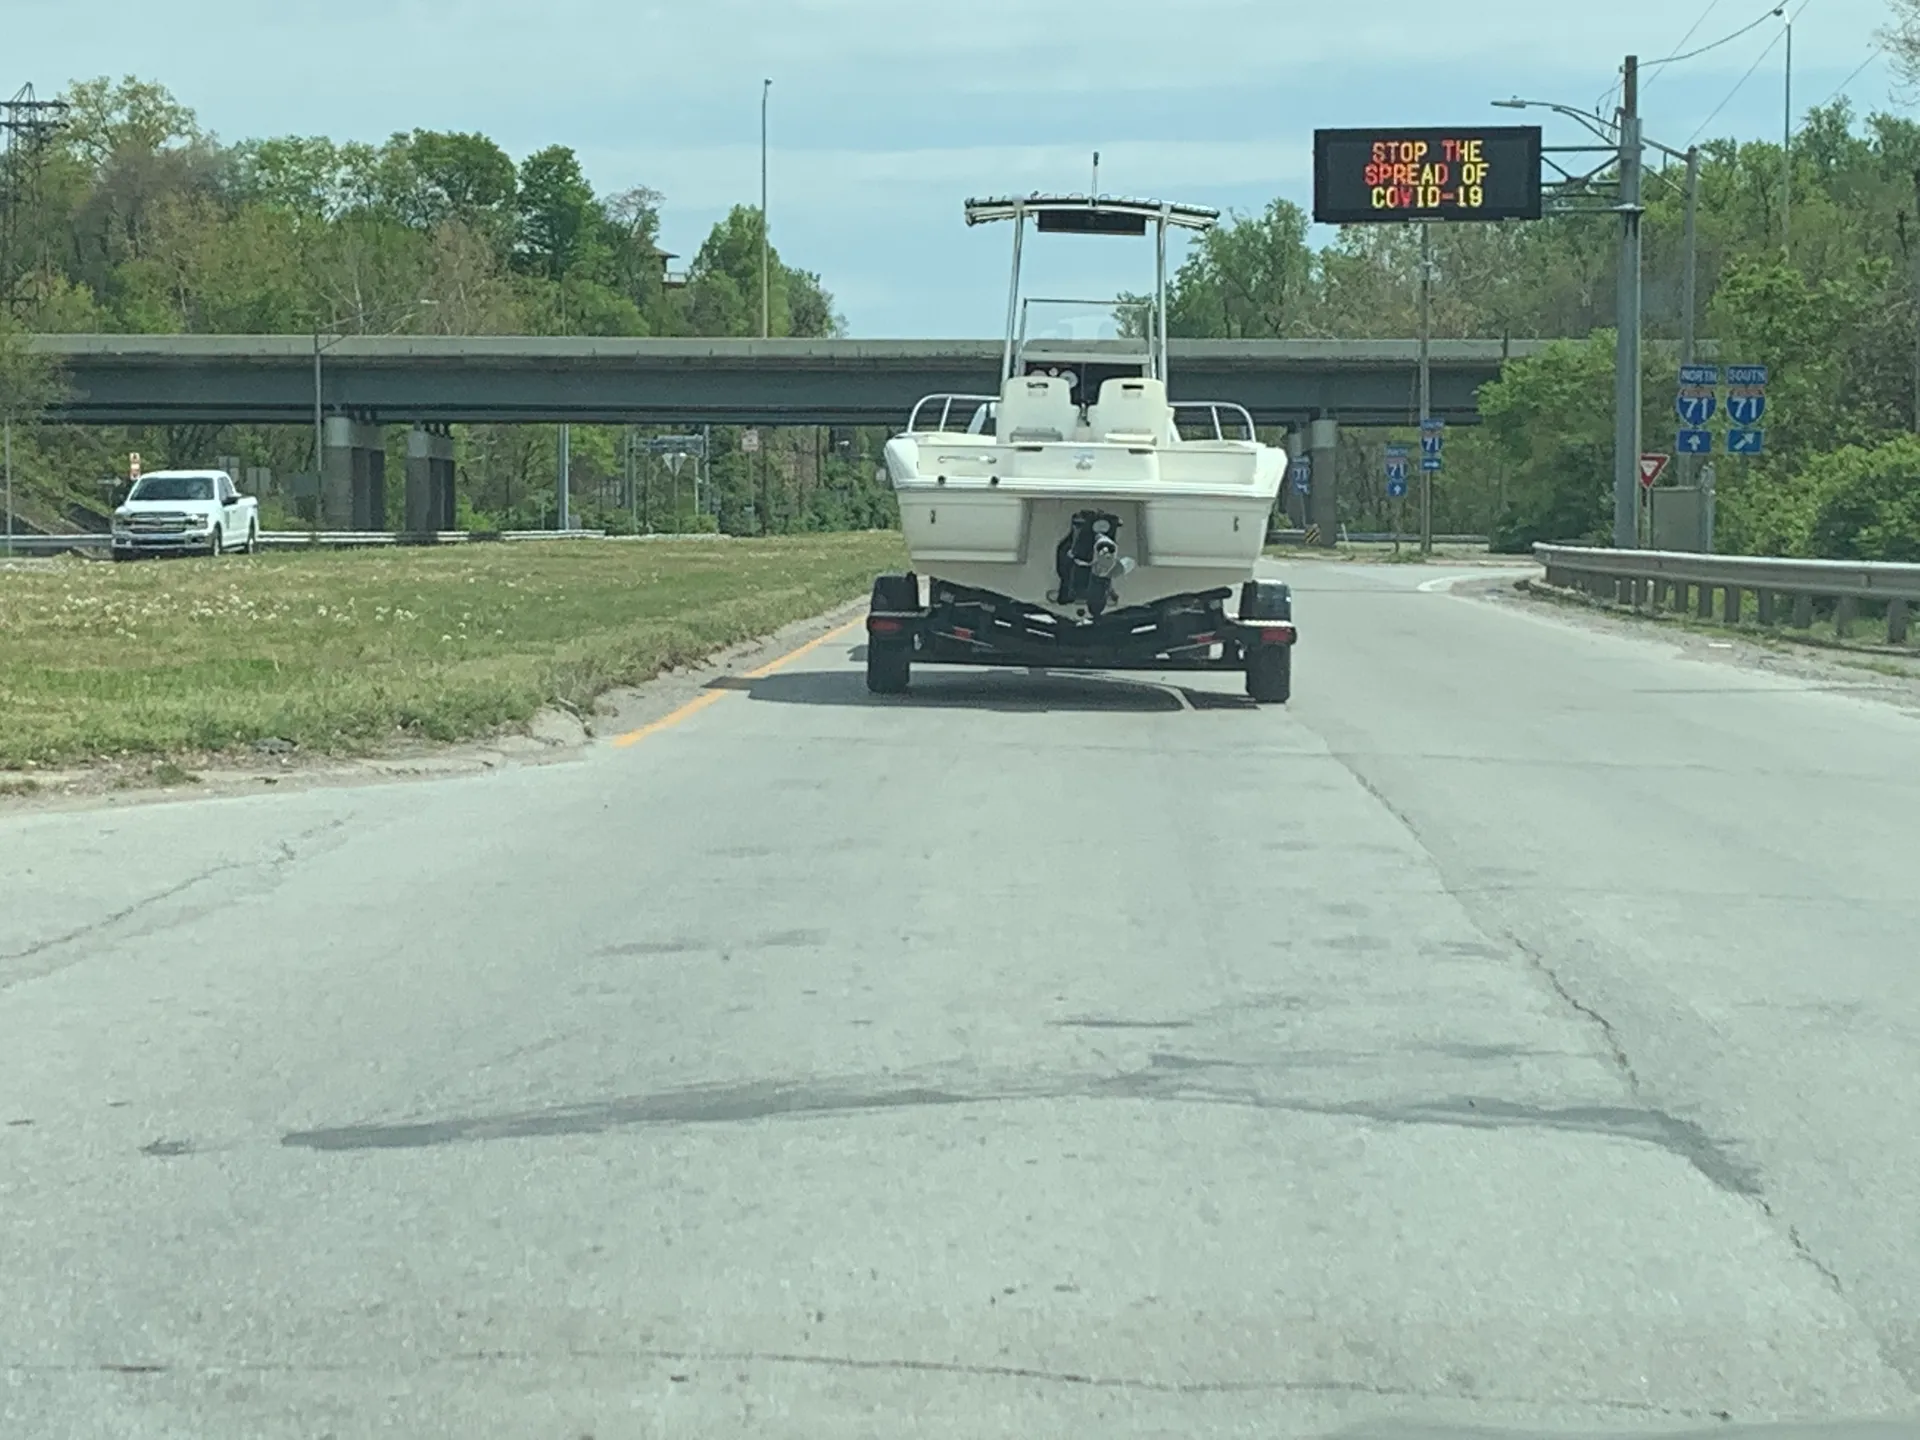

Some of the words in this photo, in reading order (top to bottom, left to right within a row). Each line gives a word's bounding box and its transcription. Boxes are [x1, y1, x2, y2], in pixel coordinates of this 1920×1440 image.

[1372, 141, 1428, 163] STOP
[1442, 140, 1484, 162] THE
[1364, 163, 1449, 186] SPREAD
[1462, 163, 1490, 185] OF
[1372, 186, 1483, 208] COVID-19
[1729, 369, 1765, 382] SOUTH
[1683, 398, 1709, 420] 71
[1731, 398, 1757, 419] 71
[1423, 436, 1439, 451] 71
[1389, 463, 1404, 476] 71
